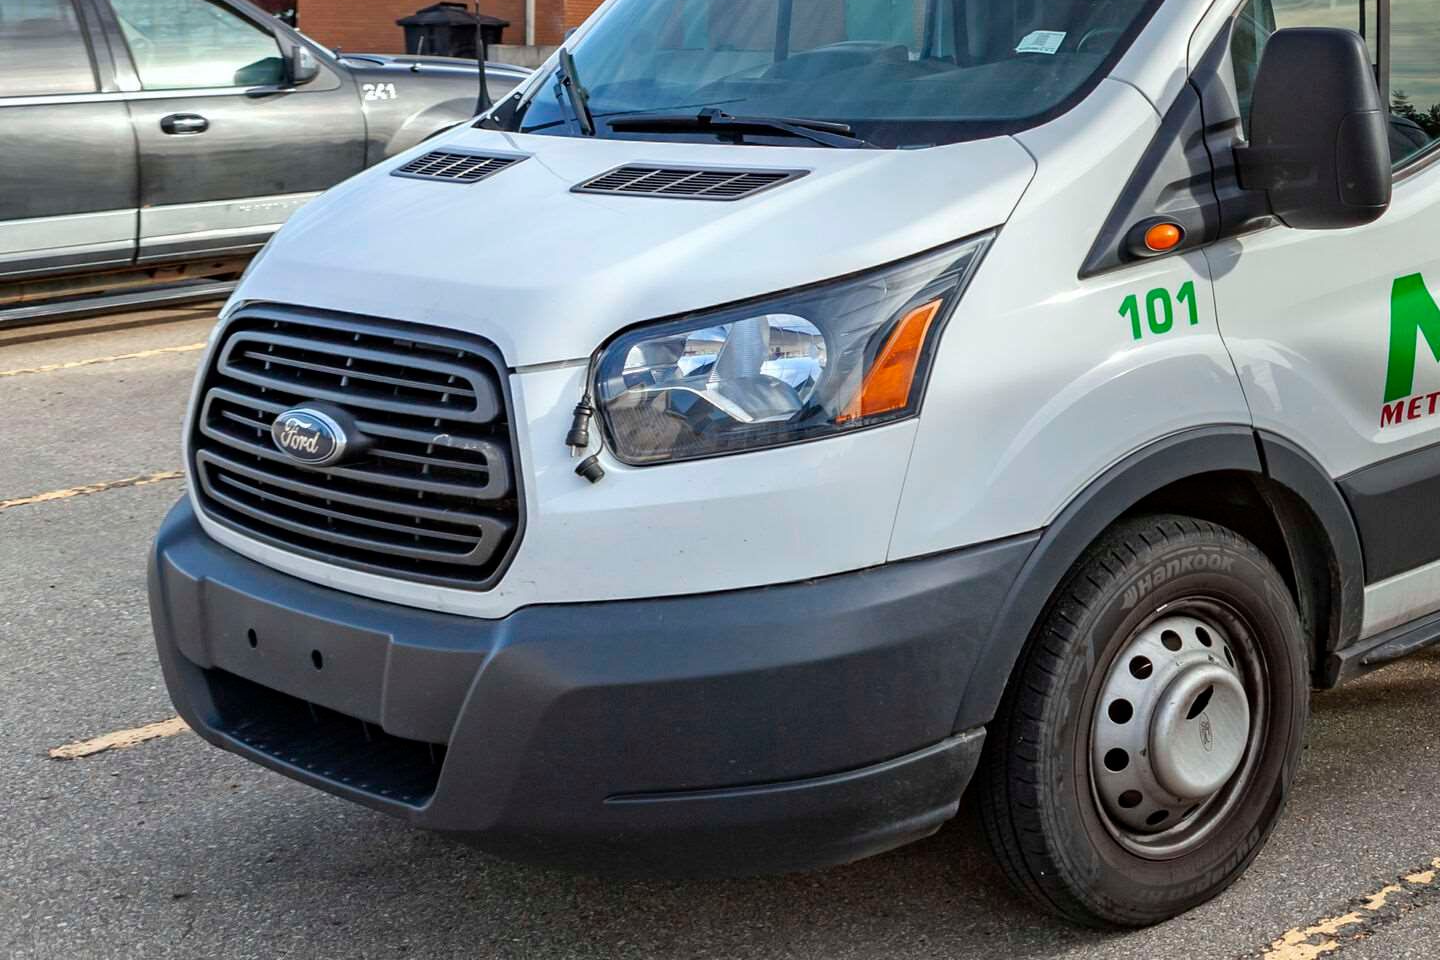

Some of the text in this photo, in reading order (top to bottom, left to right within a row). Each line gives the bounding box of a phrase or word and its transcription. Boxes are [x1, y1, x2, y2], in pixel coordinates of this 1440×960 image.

[363, 83, 397, 100] 241
[1118, 280, 1198, 340] 101
[281, 418, 320, 453] Ford
